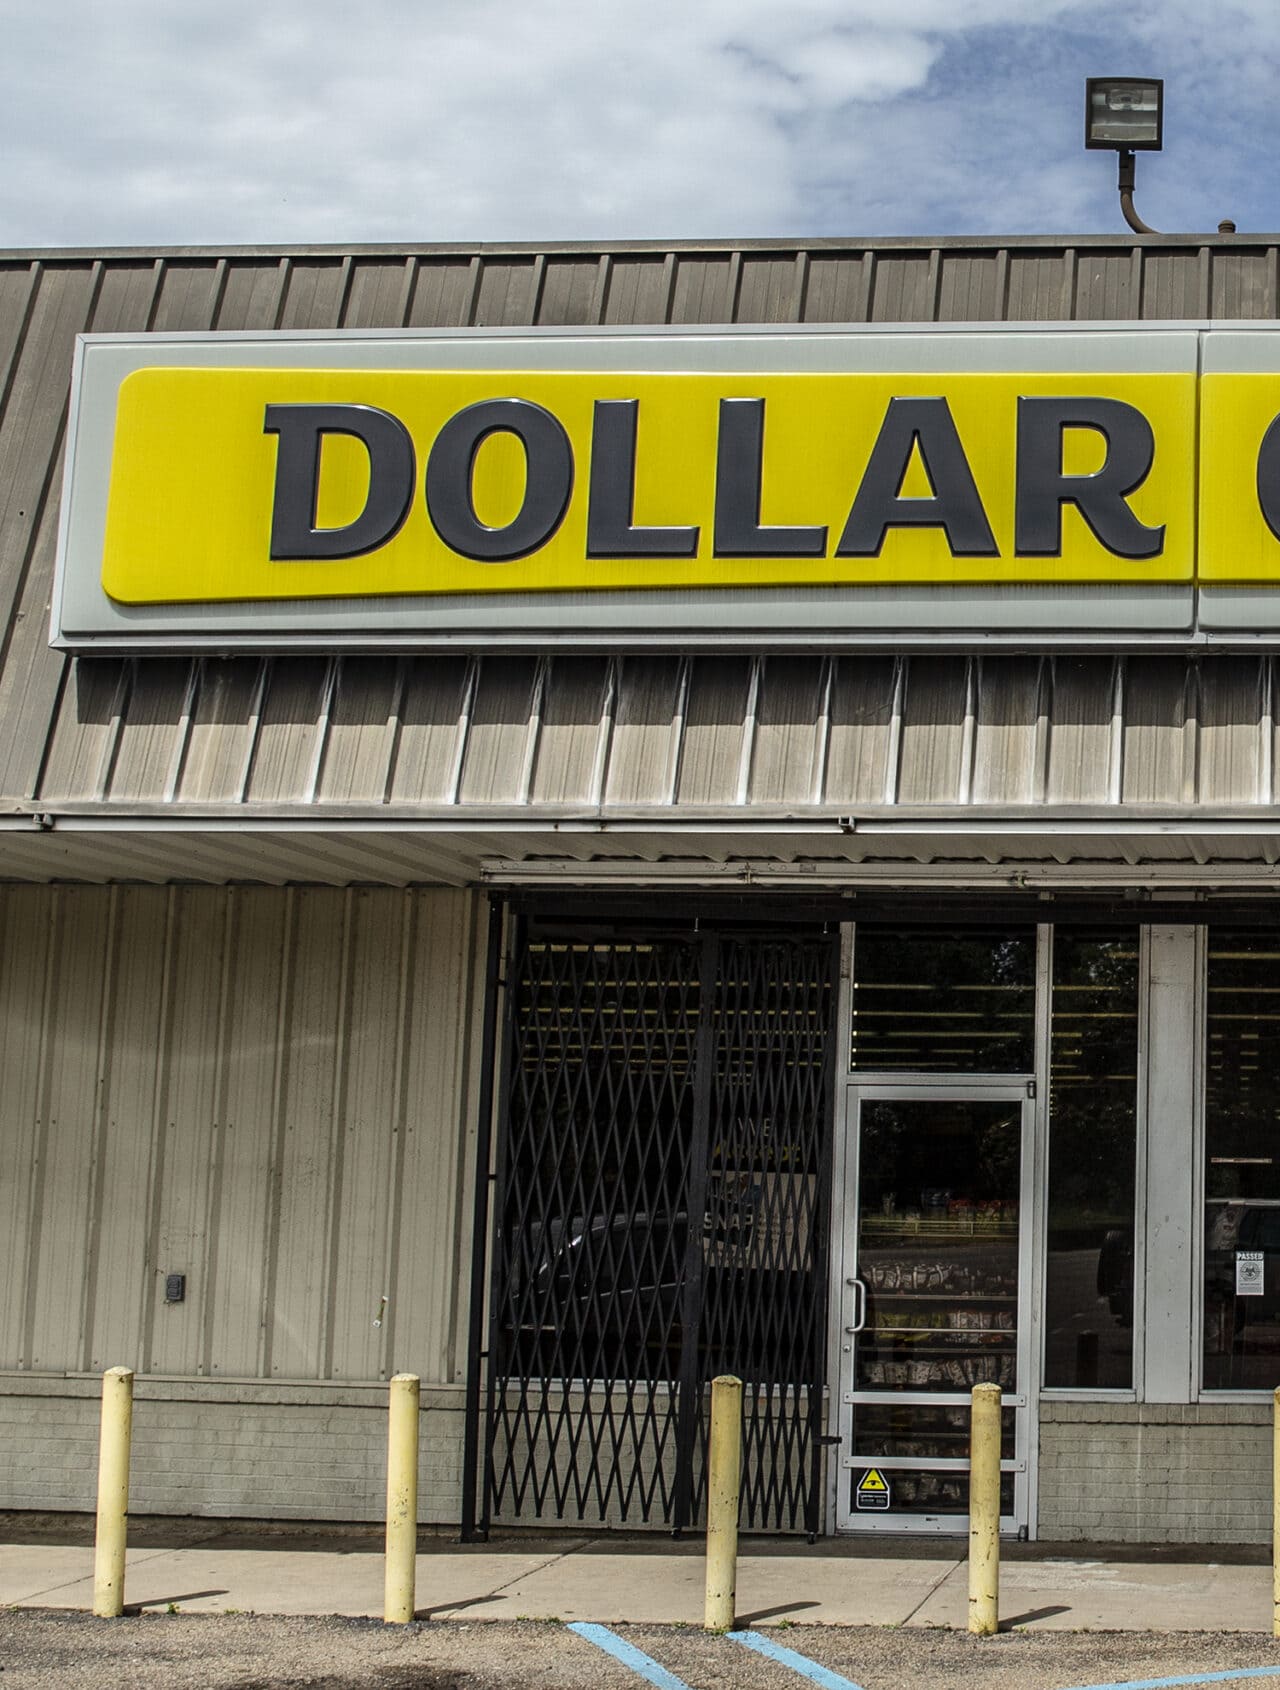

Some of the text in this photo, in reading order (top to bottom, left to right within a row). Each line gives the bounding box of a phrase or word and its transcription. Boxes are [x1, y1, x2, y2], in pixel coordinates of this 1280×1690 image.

[263, 396, 1166, 562] DOLLAR
[703, 1211, 754, 1230] SNAP
[1237, 1252, 1264, 1261] PASSED
